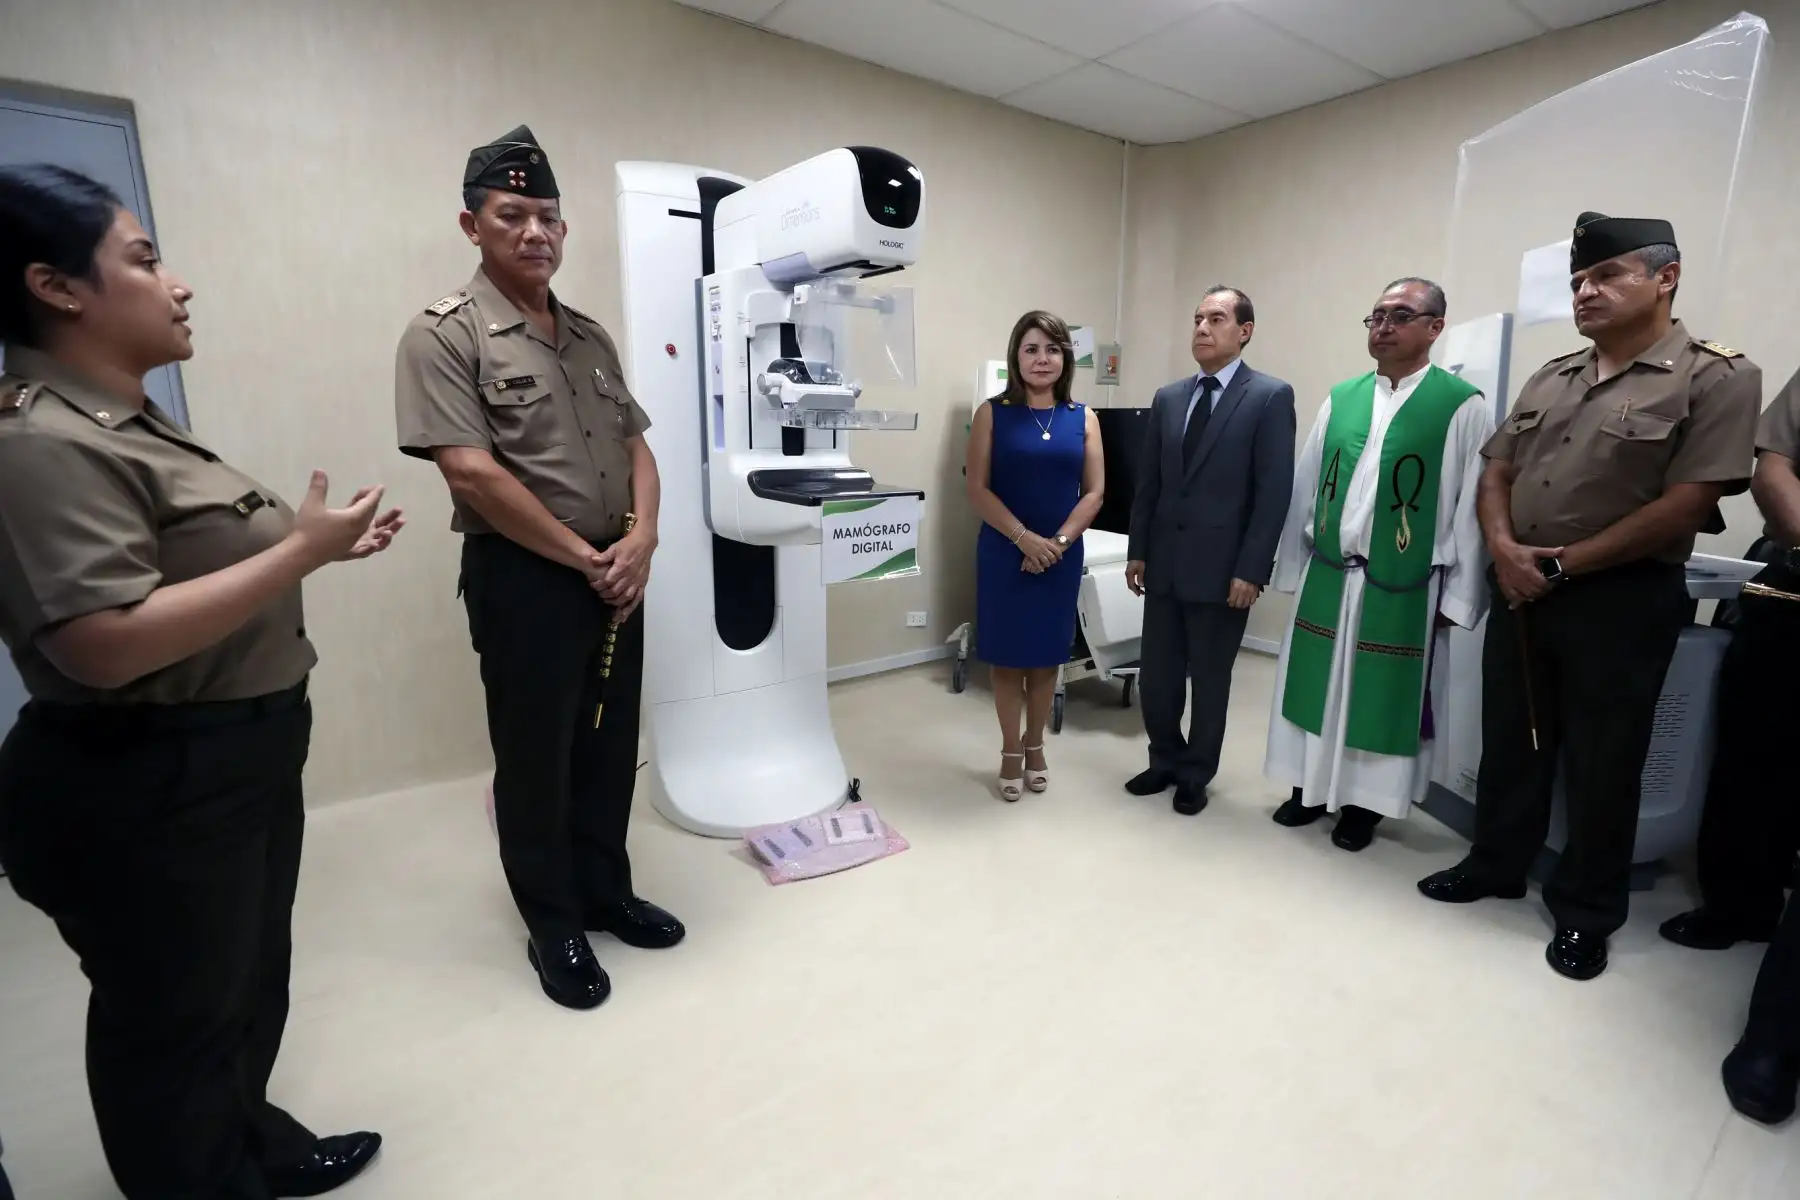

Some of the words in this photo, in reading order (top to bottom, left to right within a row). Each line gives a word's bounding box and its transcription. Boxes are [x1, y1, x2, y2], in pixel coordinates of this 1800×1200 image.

[879, 239, 904, 249] HOLOGIC
[832, 522, 911, 540] MAMÓGRAFO
[851, 540, 894, 555] DIGITAL
